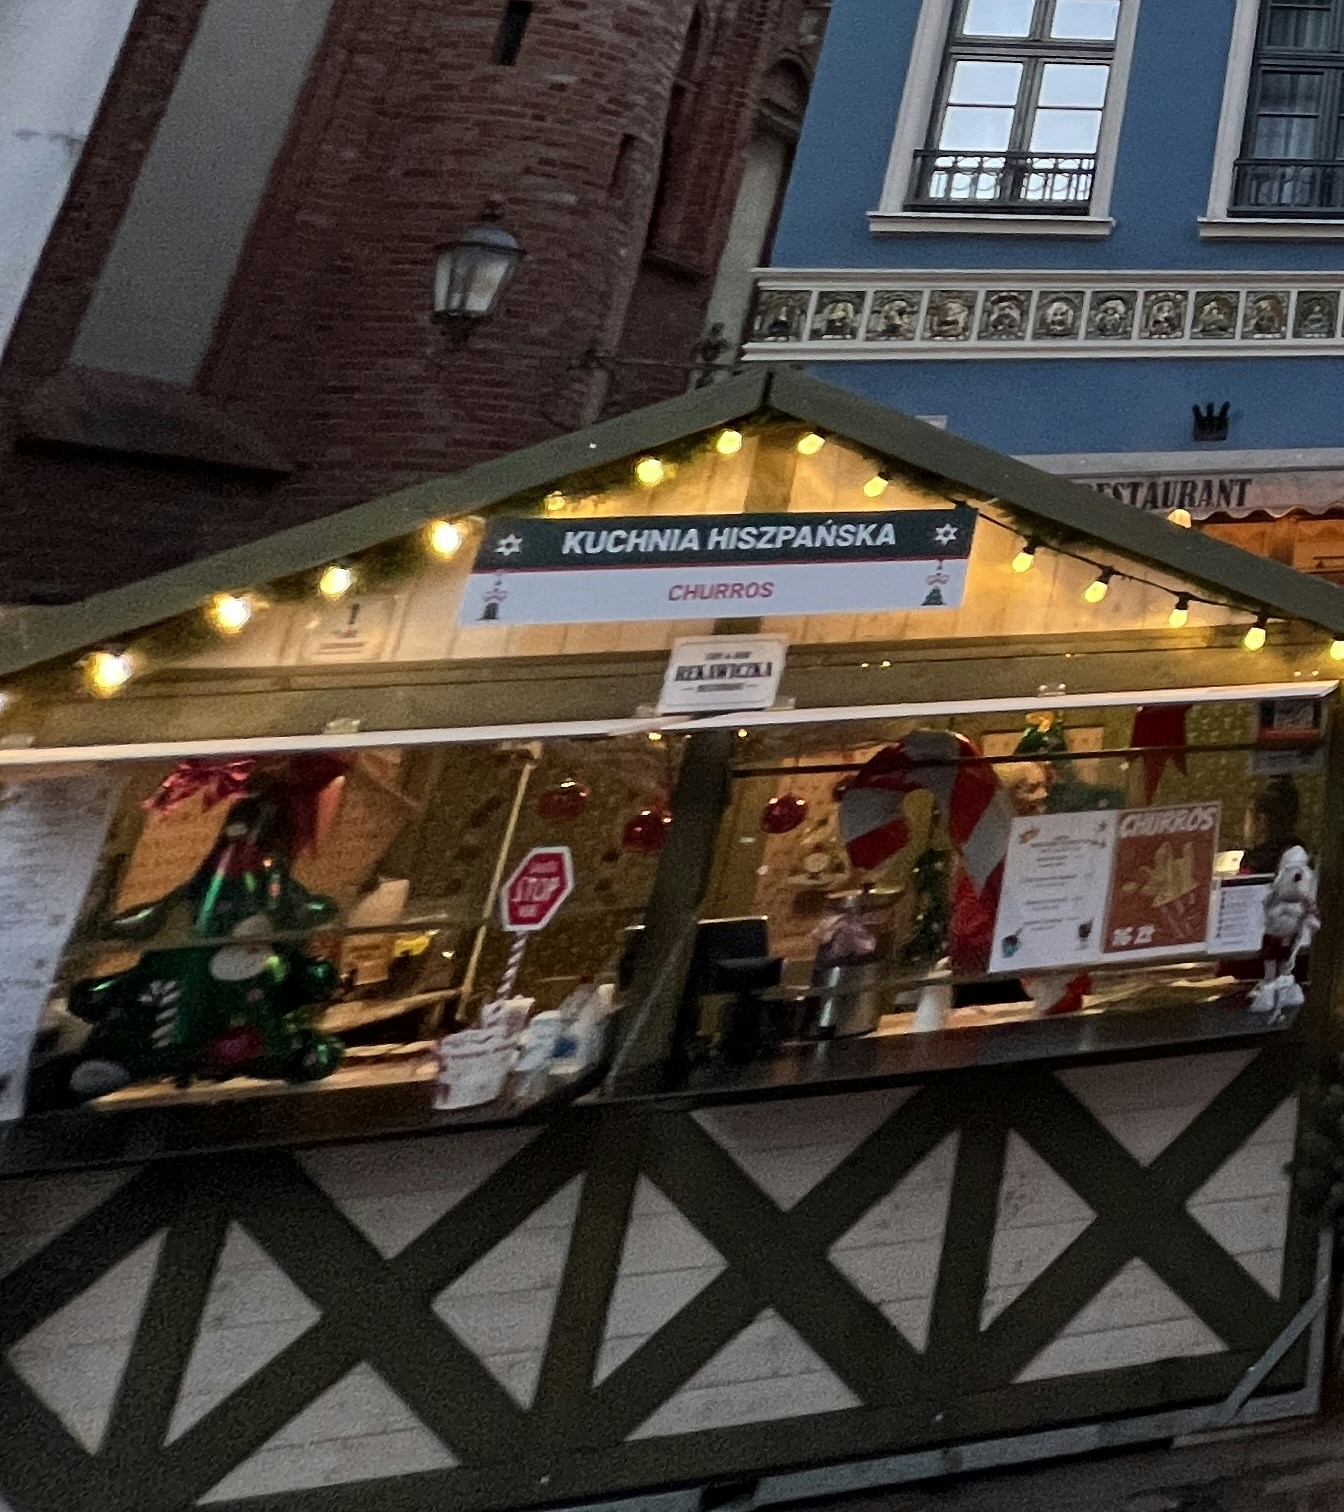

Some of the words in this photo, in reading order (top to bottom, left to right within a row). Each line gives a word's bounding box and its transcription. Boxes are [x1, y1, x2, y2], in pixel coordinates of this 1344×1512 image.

[1094, 478, 1253, 510] STAURANT
[562, 525, 699, 556] KUCHNIA
[707, 519, 897, 550] HISZPAŃSKA
[667, 581, 776, 603] CHURROS
[1120, 806, 1215, 837] CHURROS
[511, 876, 561, 902] STOP
